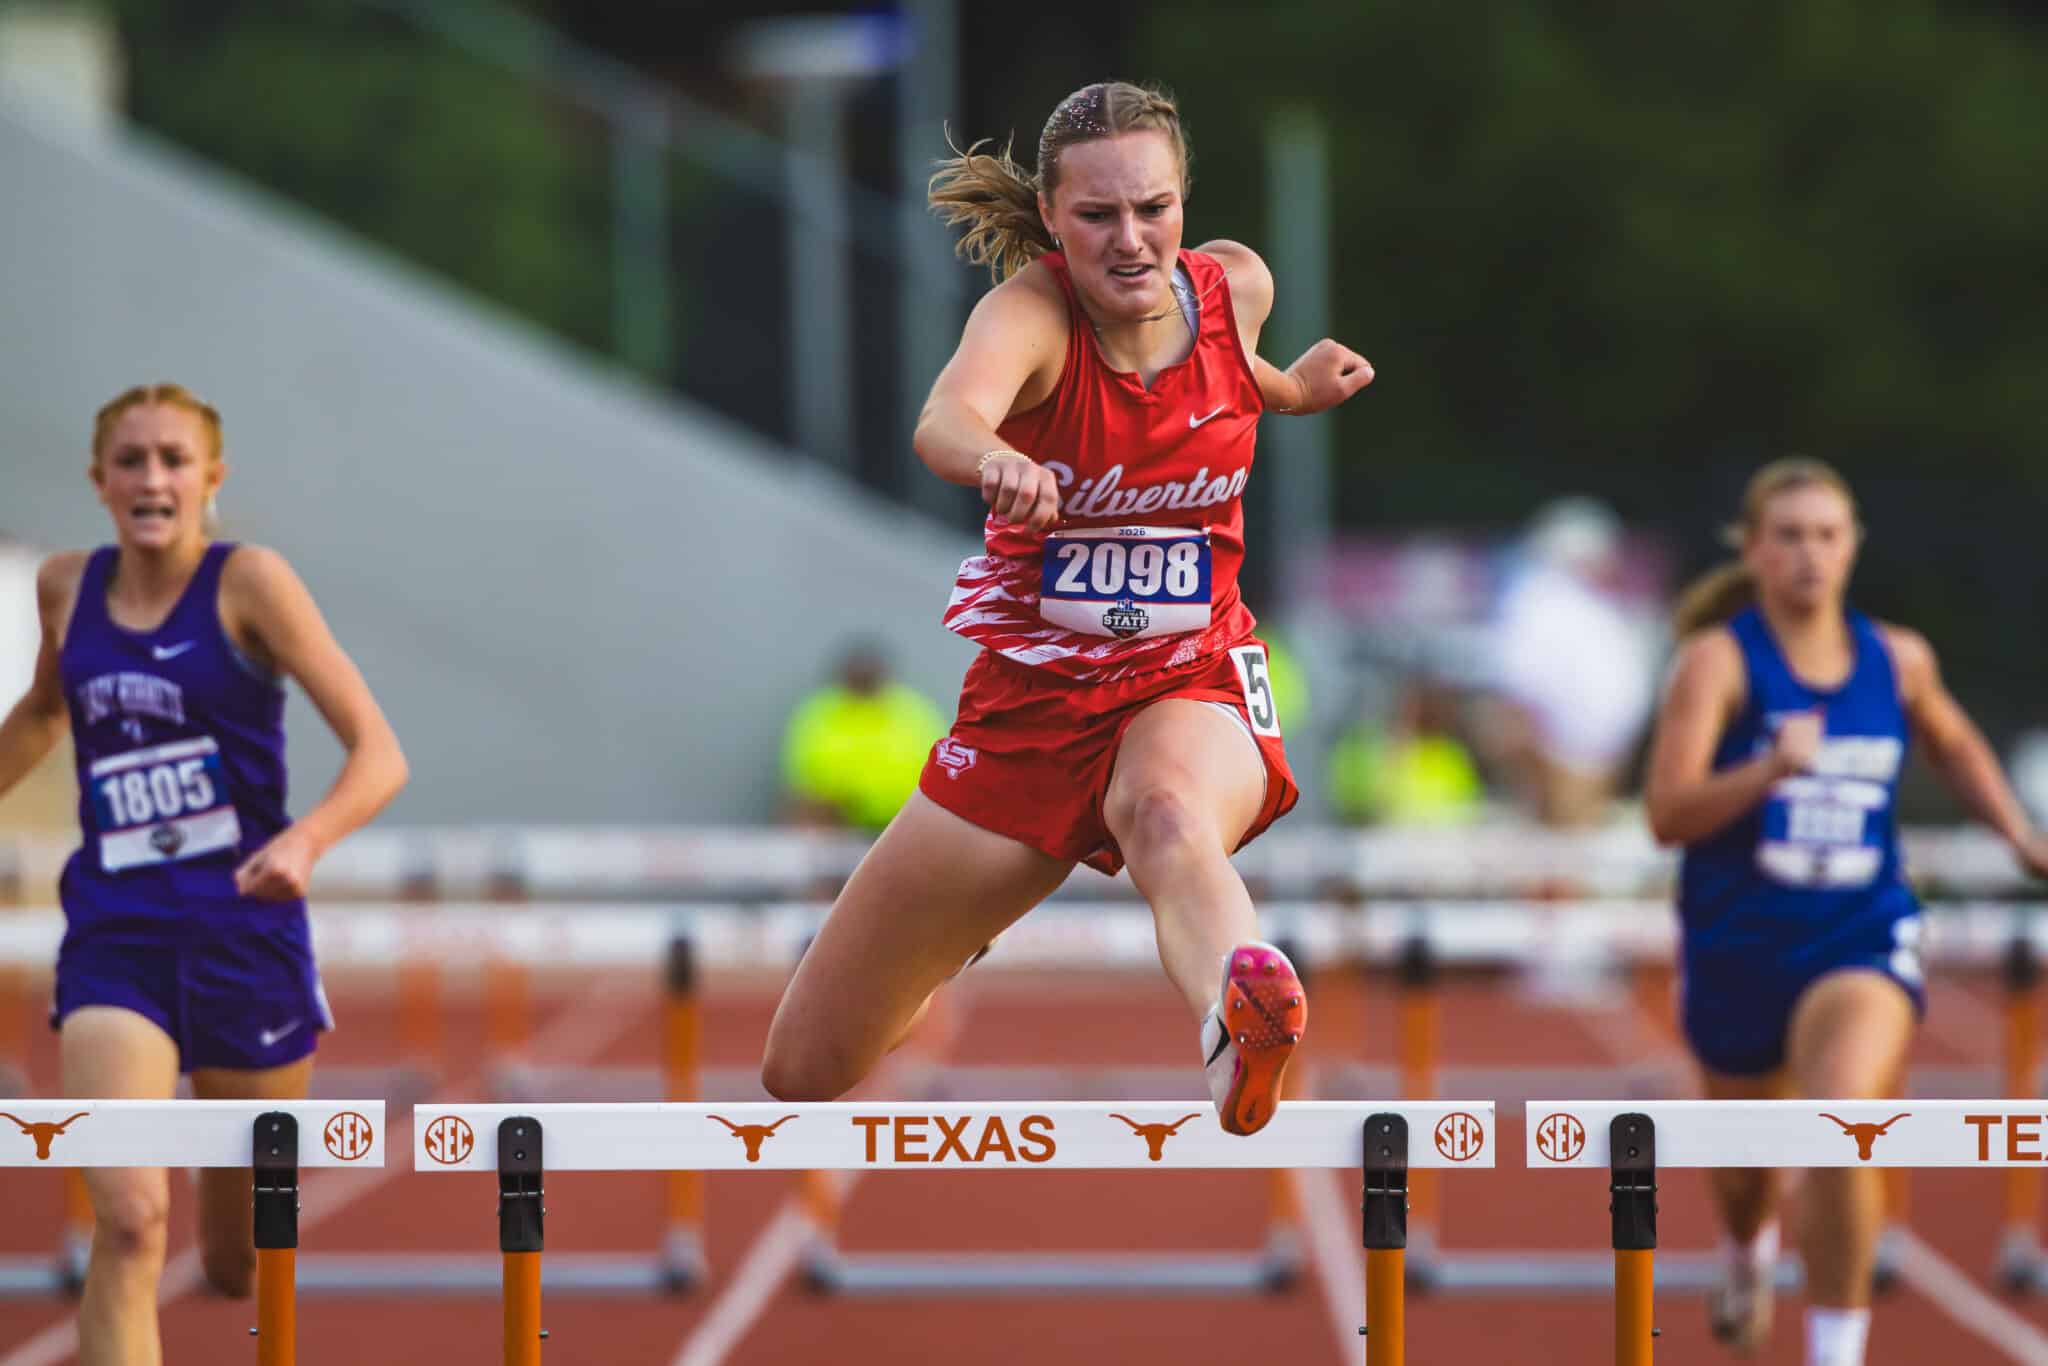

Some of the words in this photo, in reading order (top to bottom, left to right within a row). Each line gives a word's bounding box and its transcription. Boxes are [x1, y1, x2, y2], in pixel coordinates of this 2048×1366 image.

[1118, 527, 1146, 537] 2026
[1054, 541, 1200, 598] 2098
[1103, 615, 1148, 627] STATE
[1241, 652, 1273, 729] 5
[102, 759, 216, 826] 1805
[325, 1112, 373, 1160] SEC
[425, 1116, 474, 1164] SEC
[851, 1114, 1057, 1163] TEXAS
[1435, 1112, 1484, 1161] SEC
[1536, 1113, 1585, 1162] SEC
[1964, 1115, 2048, 1161] TE
